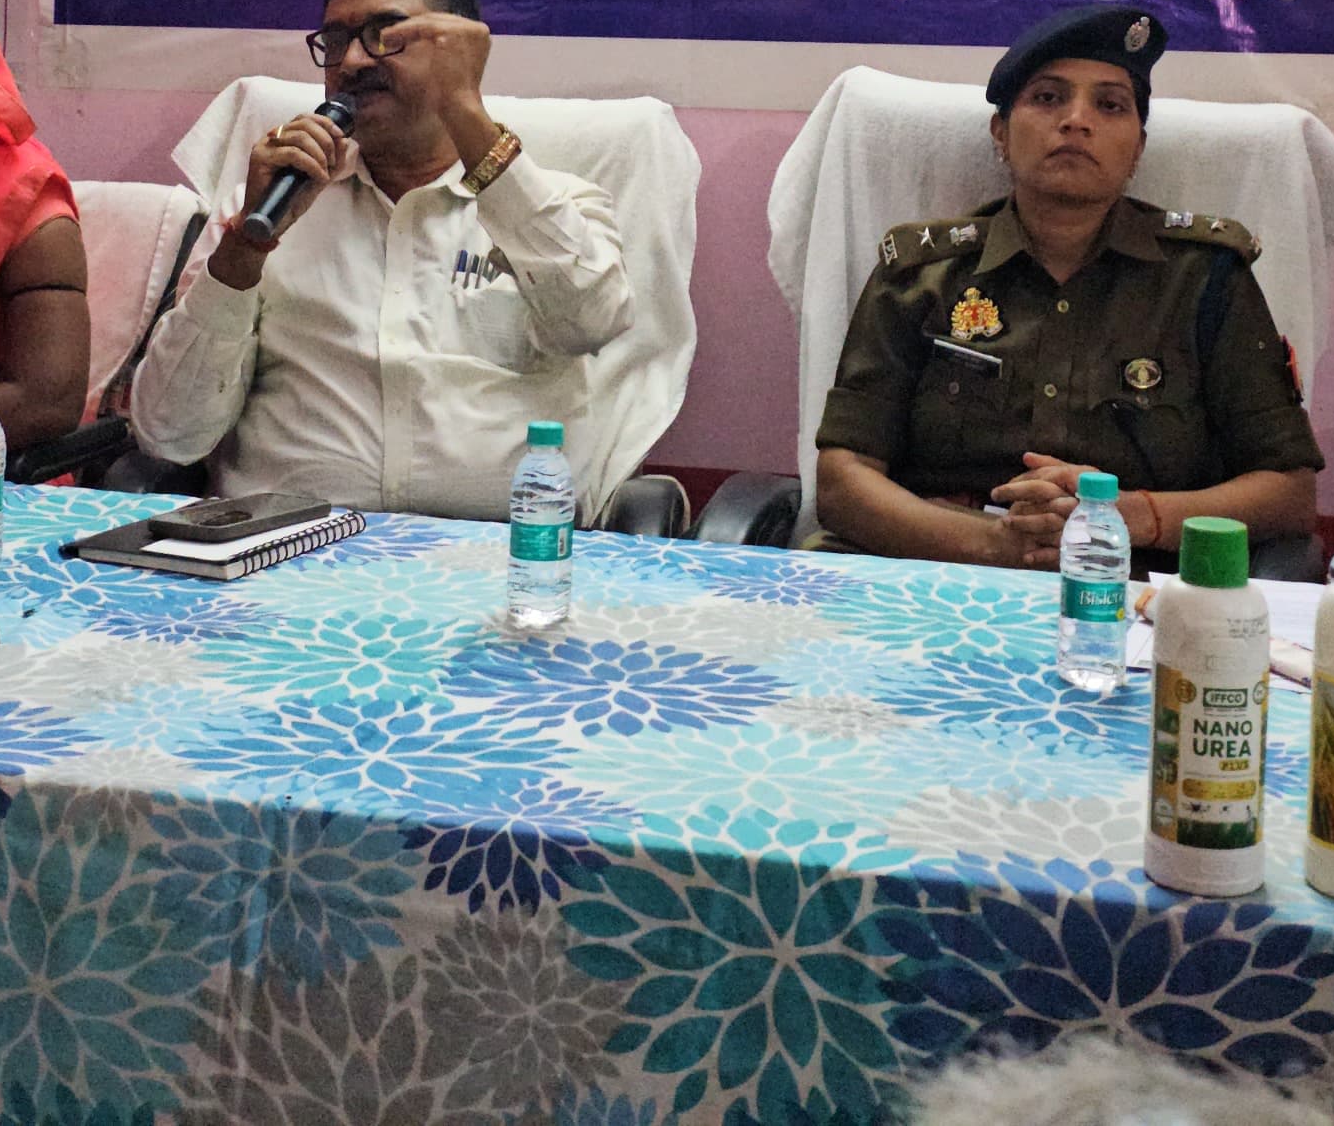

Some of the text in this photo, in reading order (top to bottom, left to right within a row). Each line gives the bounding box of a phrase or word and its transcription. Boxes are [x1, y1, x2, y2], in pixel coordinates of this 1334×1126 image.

[1210, 692, 1242, 704] IFFCO
[1193, 718, 1253, 737] NANO
[1193, 737, 1252, 758] UREA
